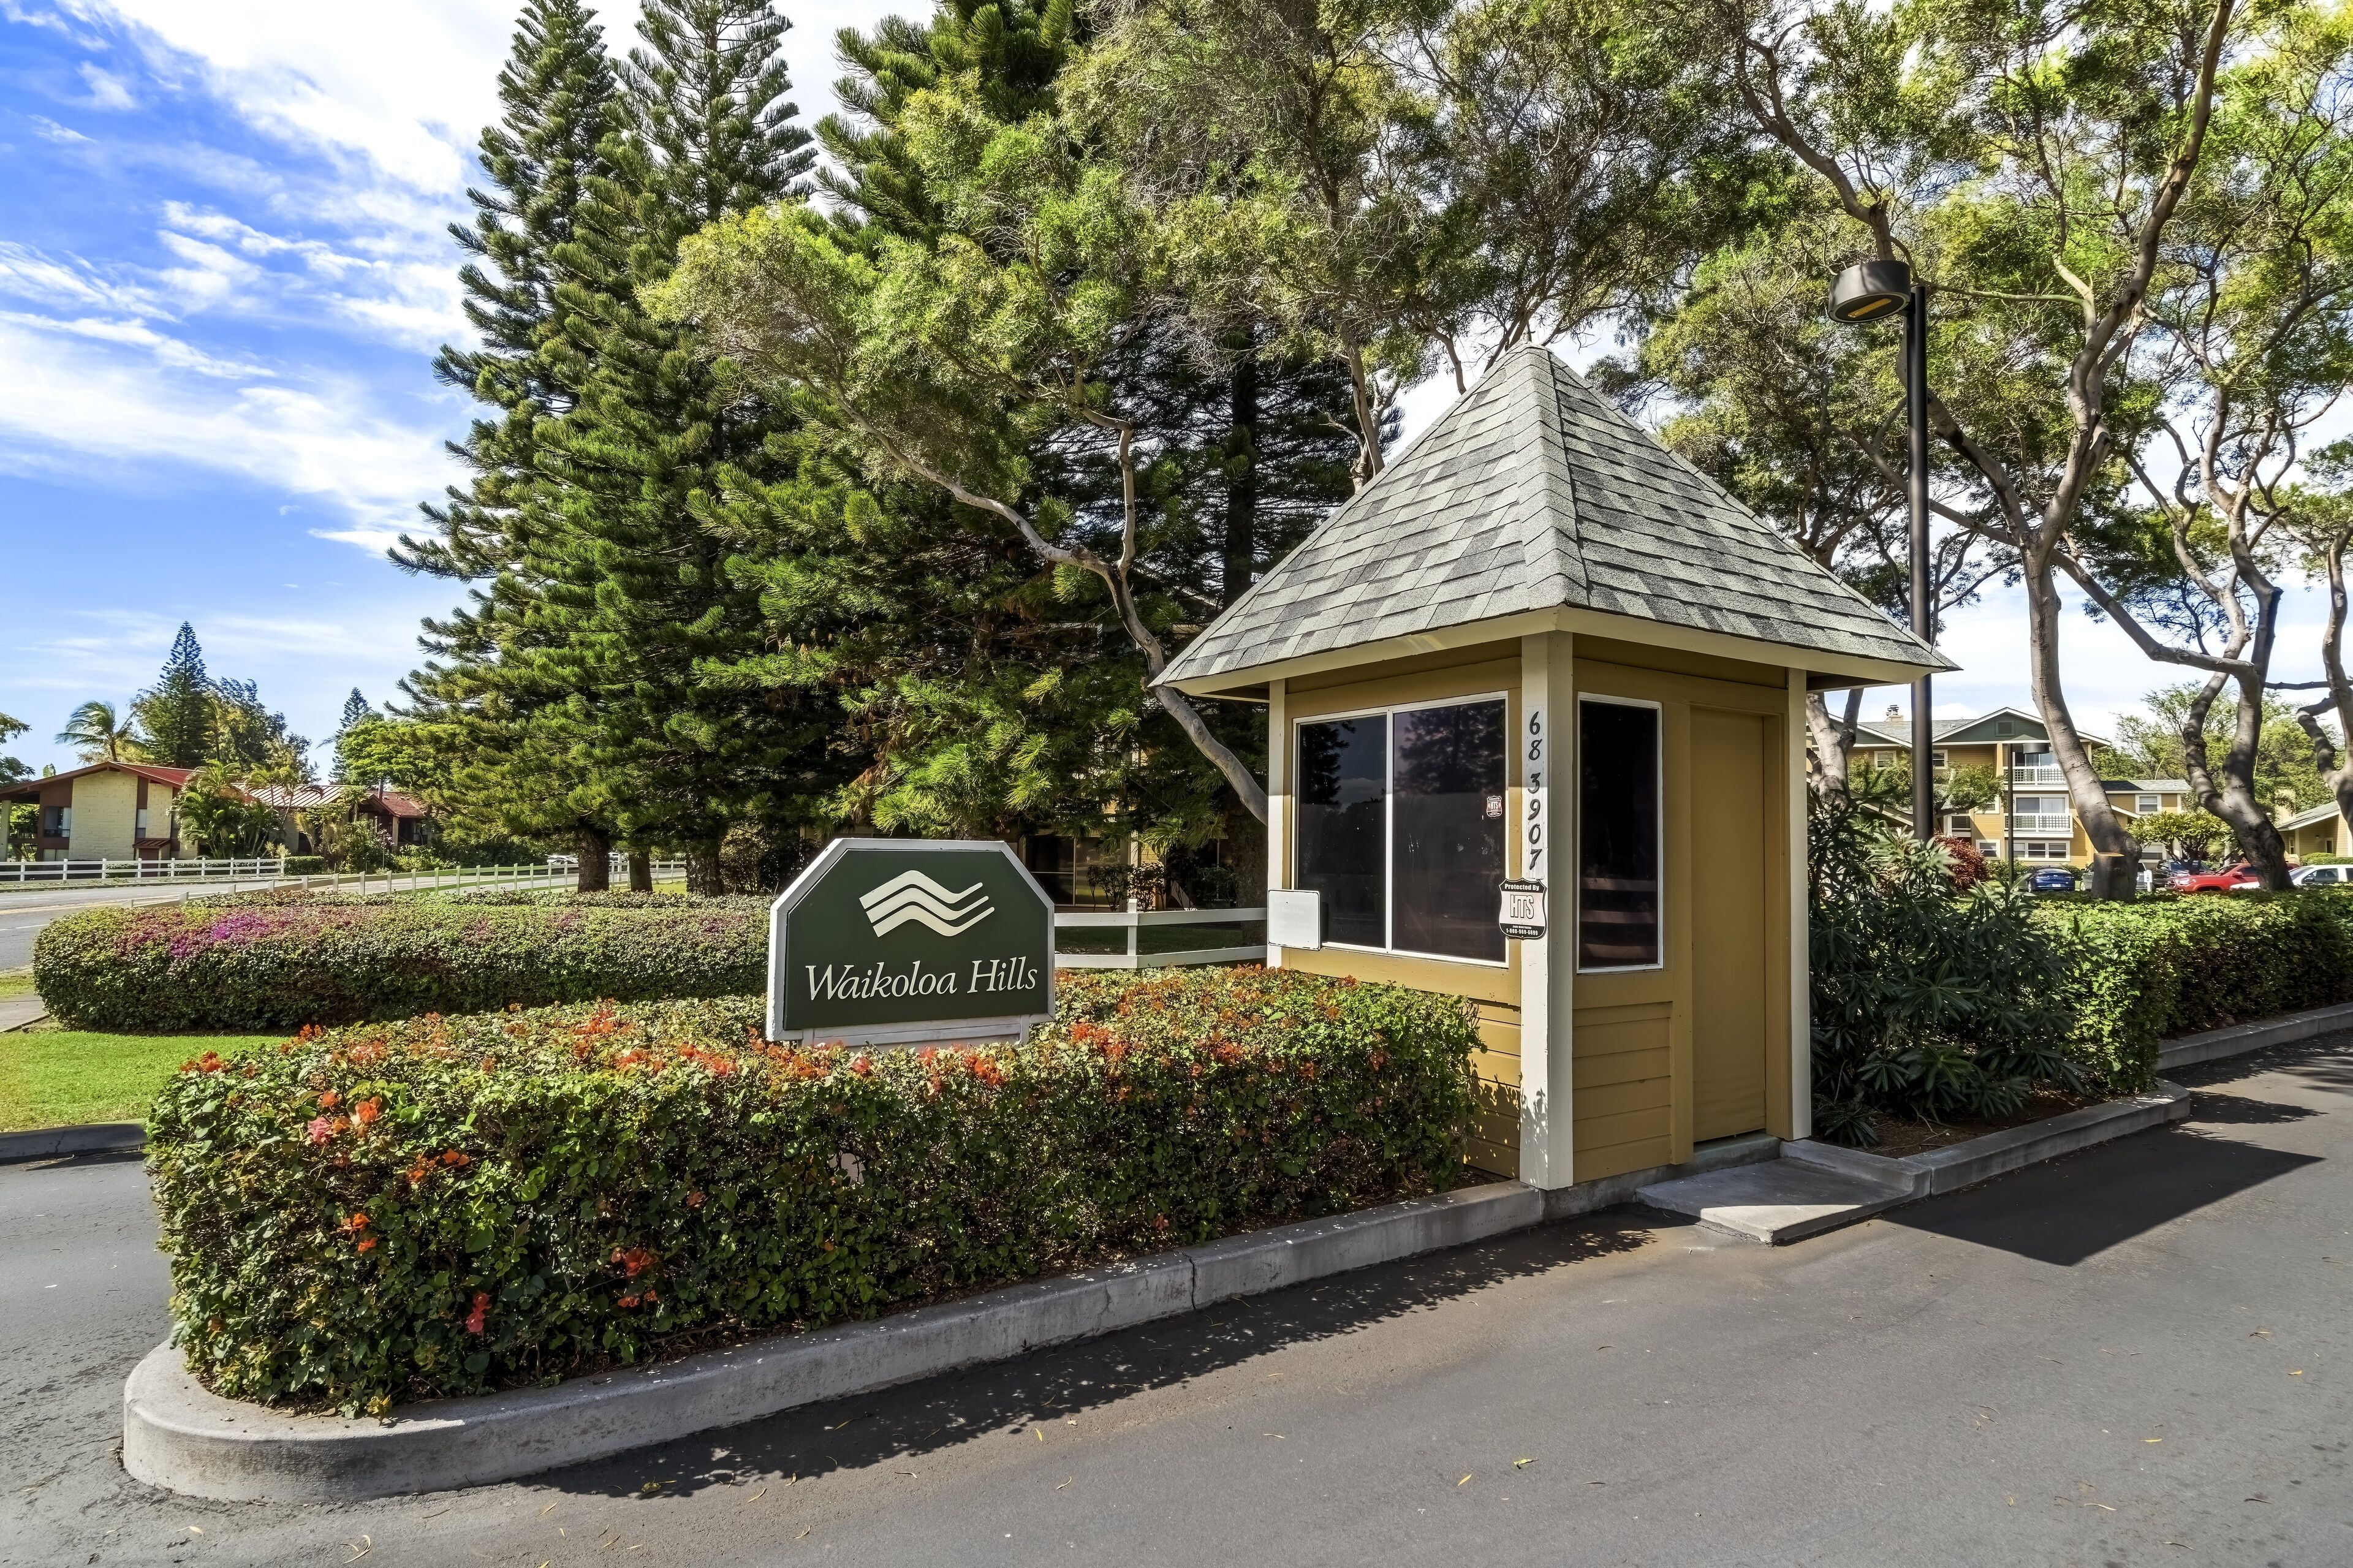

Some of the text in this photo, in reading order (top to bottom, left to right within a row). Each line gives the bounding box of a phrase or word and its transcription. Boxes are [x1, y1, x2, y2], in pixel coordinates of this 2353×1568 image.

[1490, 801, 1499, 809] HTS
[1510, 894, 1534, 920] HTS
[805, 956, 1038, 1001] Waikoloa Hills
